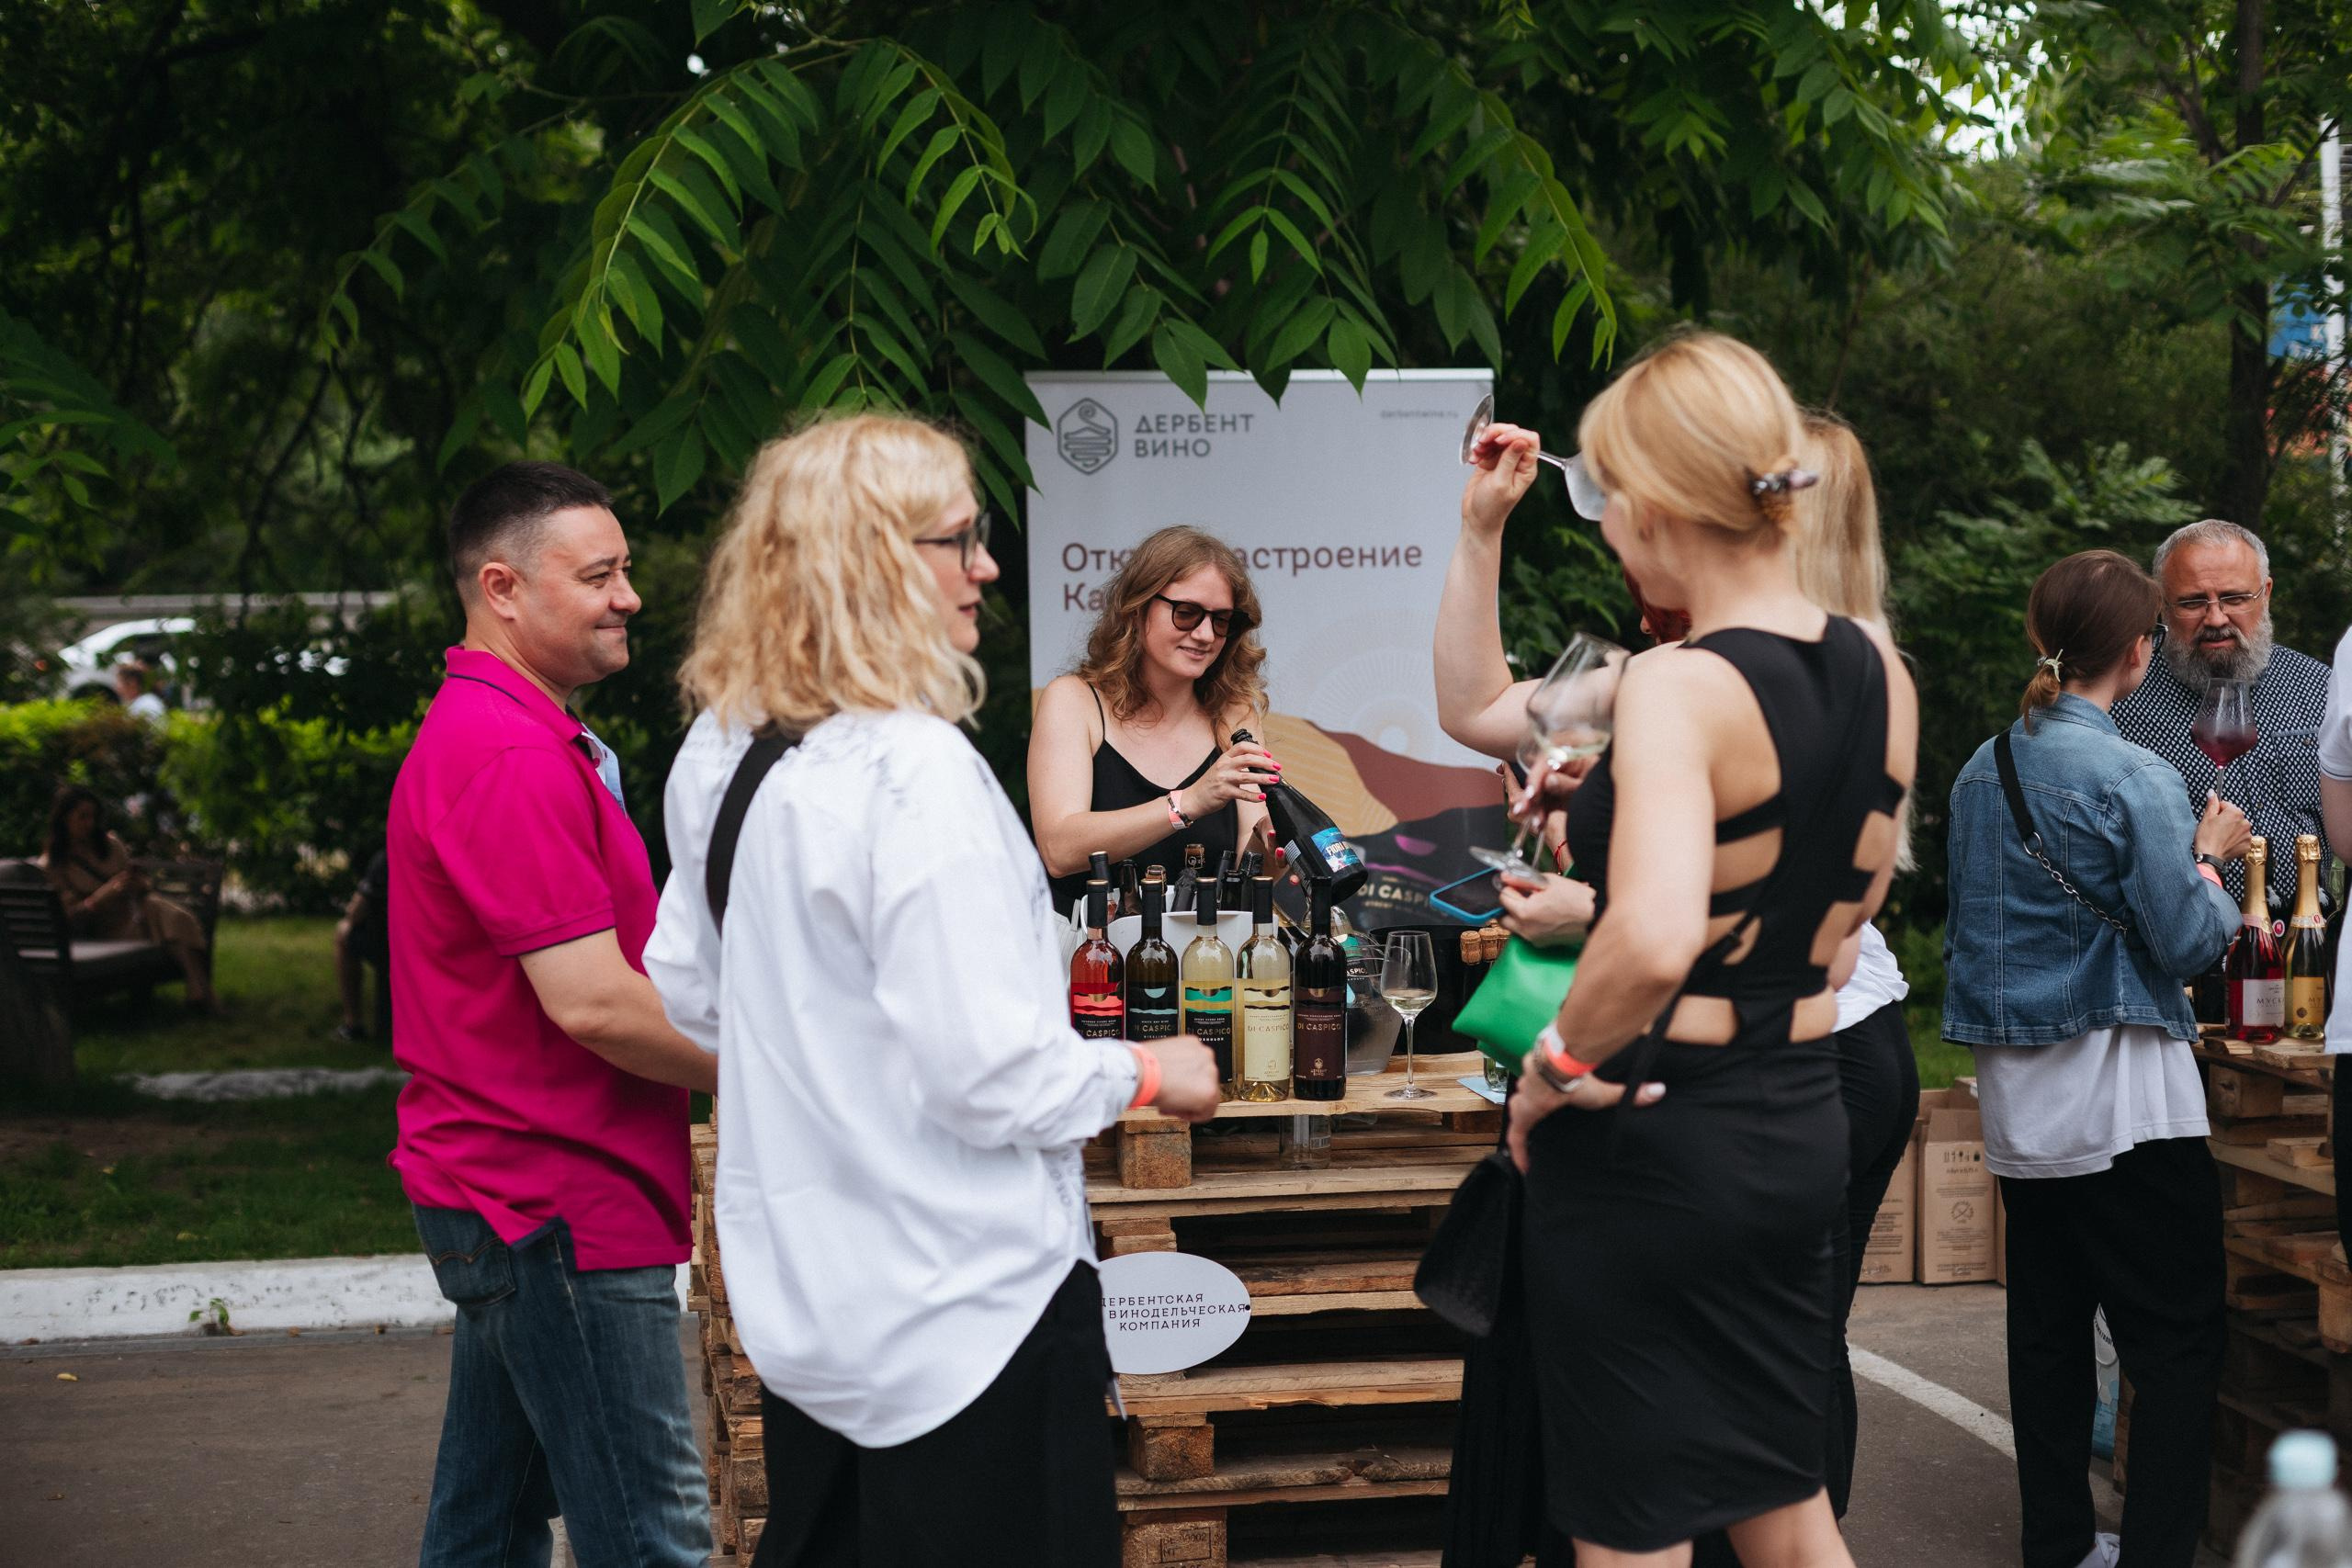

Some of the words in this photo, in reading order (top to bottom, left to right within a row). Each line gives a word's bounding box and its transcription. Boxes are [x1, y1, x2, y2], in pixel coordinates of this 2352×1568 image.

[1135, 413, 1254, 434] ДЕРБЕНТ
[1135, 438, 1211, 457] ВИНО
[1062, 542, 1130, 572] Отк
[1234, 545, 1422, 577] астроение
[1379, 885, 1429, 908] CASPI
[1142, 1023, 1175, 1032] CASPIC
[1196, 1027, 1231, 1035] CASPICO
[1108, 1303, 1246, 1319] ВИНОДЕЛЬЧЕСКАЯ
[1119, 1318, 1201, 1331] КОМПАНИЯ
